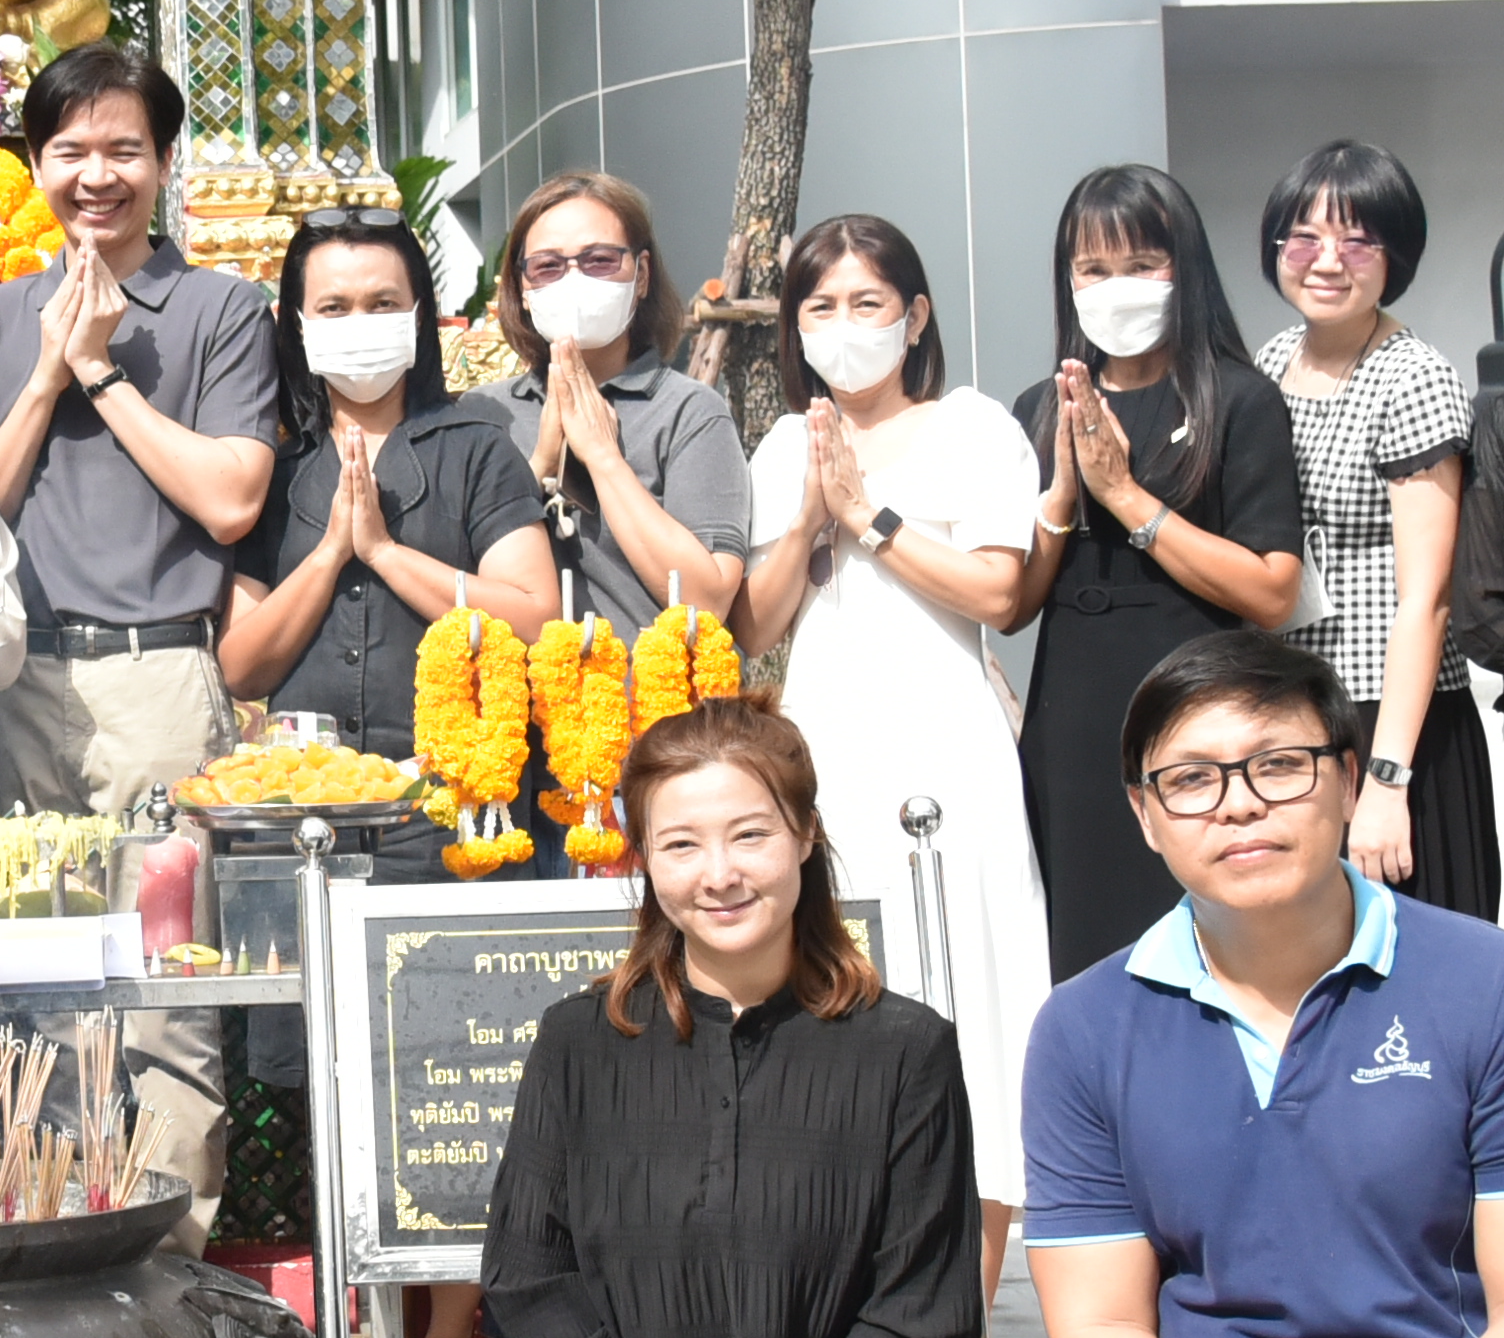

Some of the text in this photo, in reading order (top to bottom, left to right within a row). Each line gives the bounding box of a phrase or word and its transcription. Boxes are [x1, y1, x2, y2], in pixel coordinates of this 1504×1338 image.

[466, 1018, 504, 1045] โอม
[424, 1058, 461, 1085] โอม
[407, 1139, 488, 1165] ตะติยัมปิ
